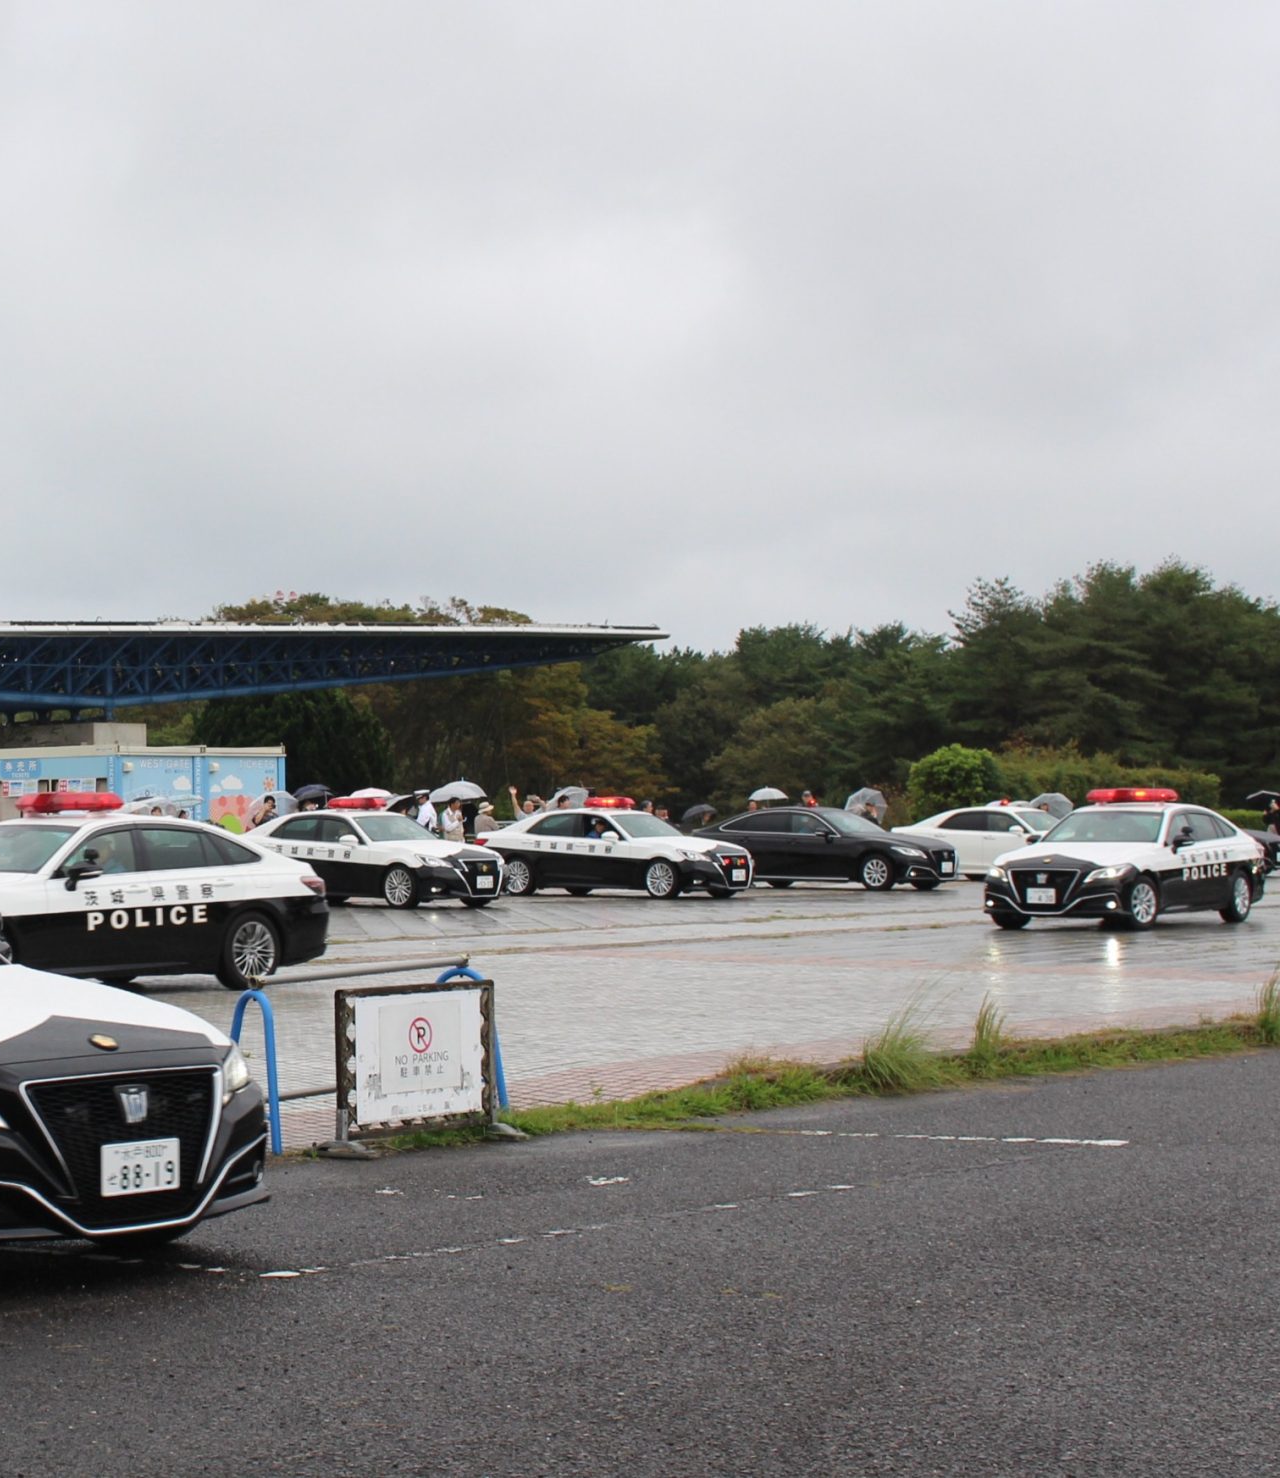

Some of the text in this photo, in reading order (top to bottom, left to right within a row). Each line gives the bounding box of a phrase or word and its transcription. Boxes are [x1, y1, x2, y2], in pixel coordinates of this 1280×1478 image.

[140, 759, 190, 769] WEST GATE
[240, 759, 275, 769] TICKETS
[1182, 863, 1228, 882] POLICE
[86, 904, 208, 931] POLICE
[395, 1051, 449, 1065] NO PARKING
[400, 1064, 444, 1078] 駐車禁止
[120, 1160, 176, 1190] 88-19
